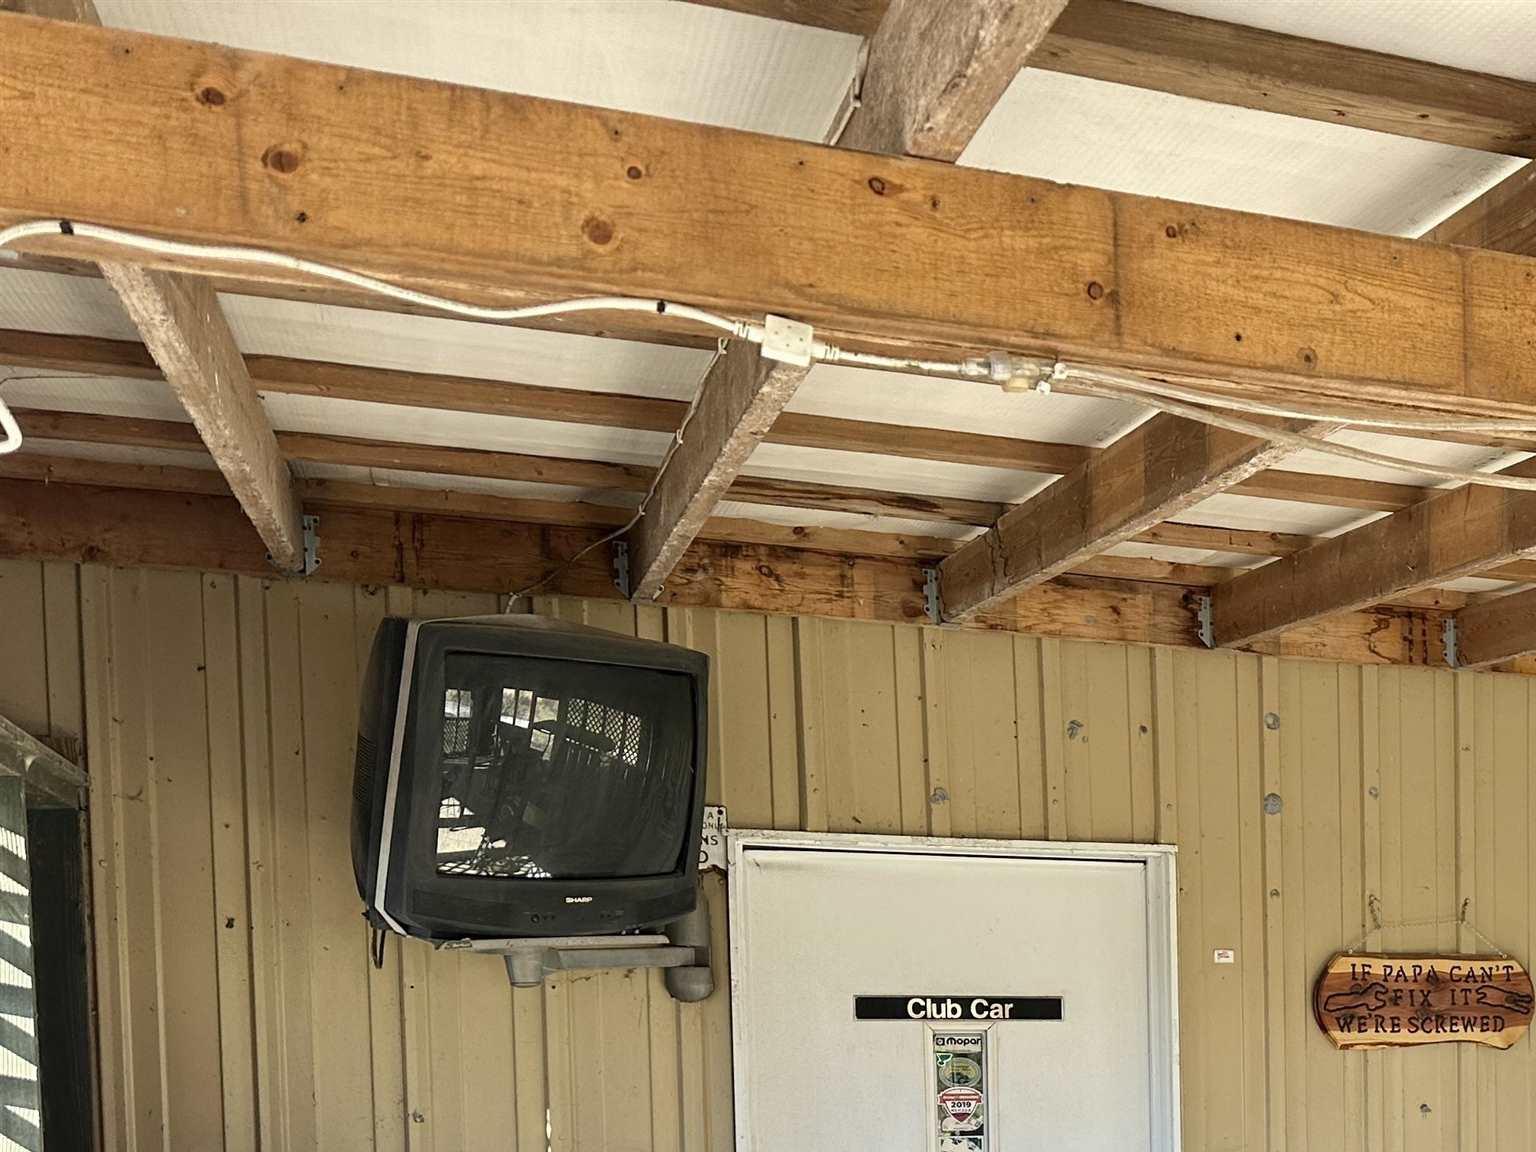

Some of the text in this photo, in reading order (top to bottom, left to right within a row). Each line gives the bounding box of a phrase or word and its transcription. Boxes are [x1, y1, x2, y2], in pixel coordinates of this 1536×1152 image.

[1351, 963, 1514, 983] IF PAPA CAN'T
[1392, 989, 1472, 1007] FIX IT
[907, 998, 1013, 1019] Club Car
[1336, 1015, 1401, 1033] WE'RE
